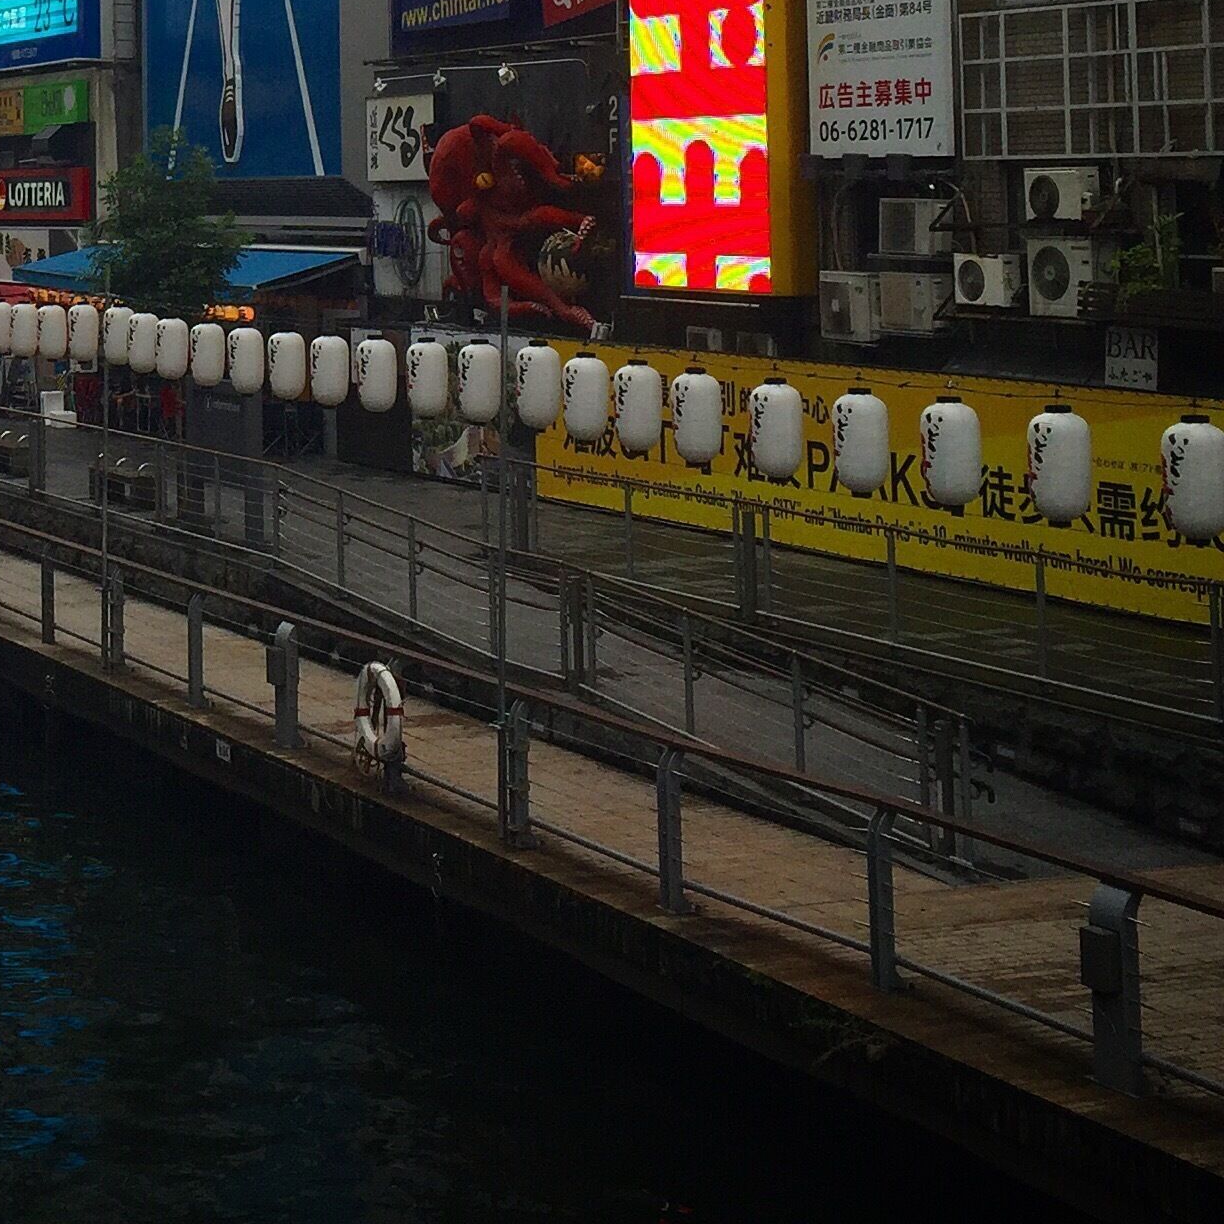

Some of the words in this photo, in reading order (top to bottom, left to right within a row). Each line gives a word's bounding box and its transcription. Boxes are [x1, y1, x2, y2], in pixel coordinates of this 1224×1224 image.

[818, 76, 933, 111] 広告主募集中
[819, 116, 935, 143] 06-6281-1717
[8, 180, 65, 207] LOTTERIA
[1107, 329, 1157, 361] BAR
